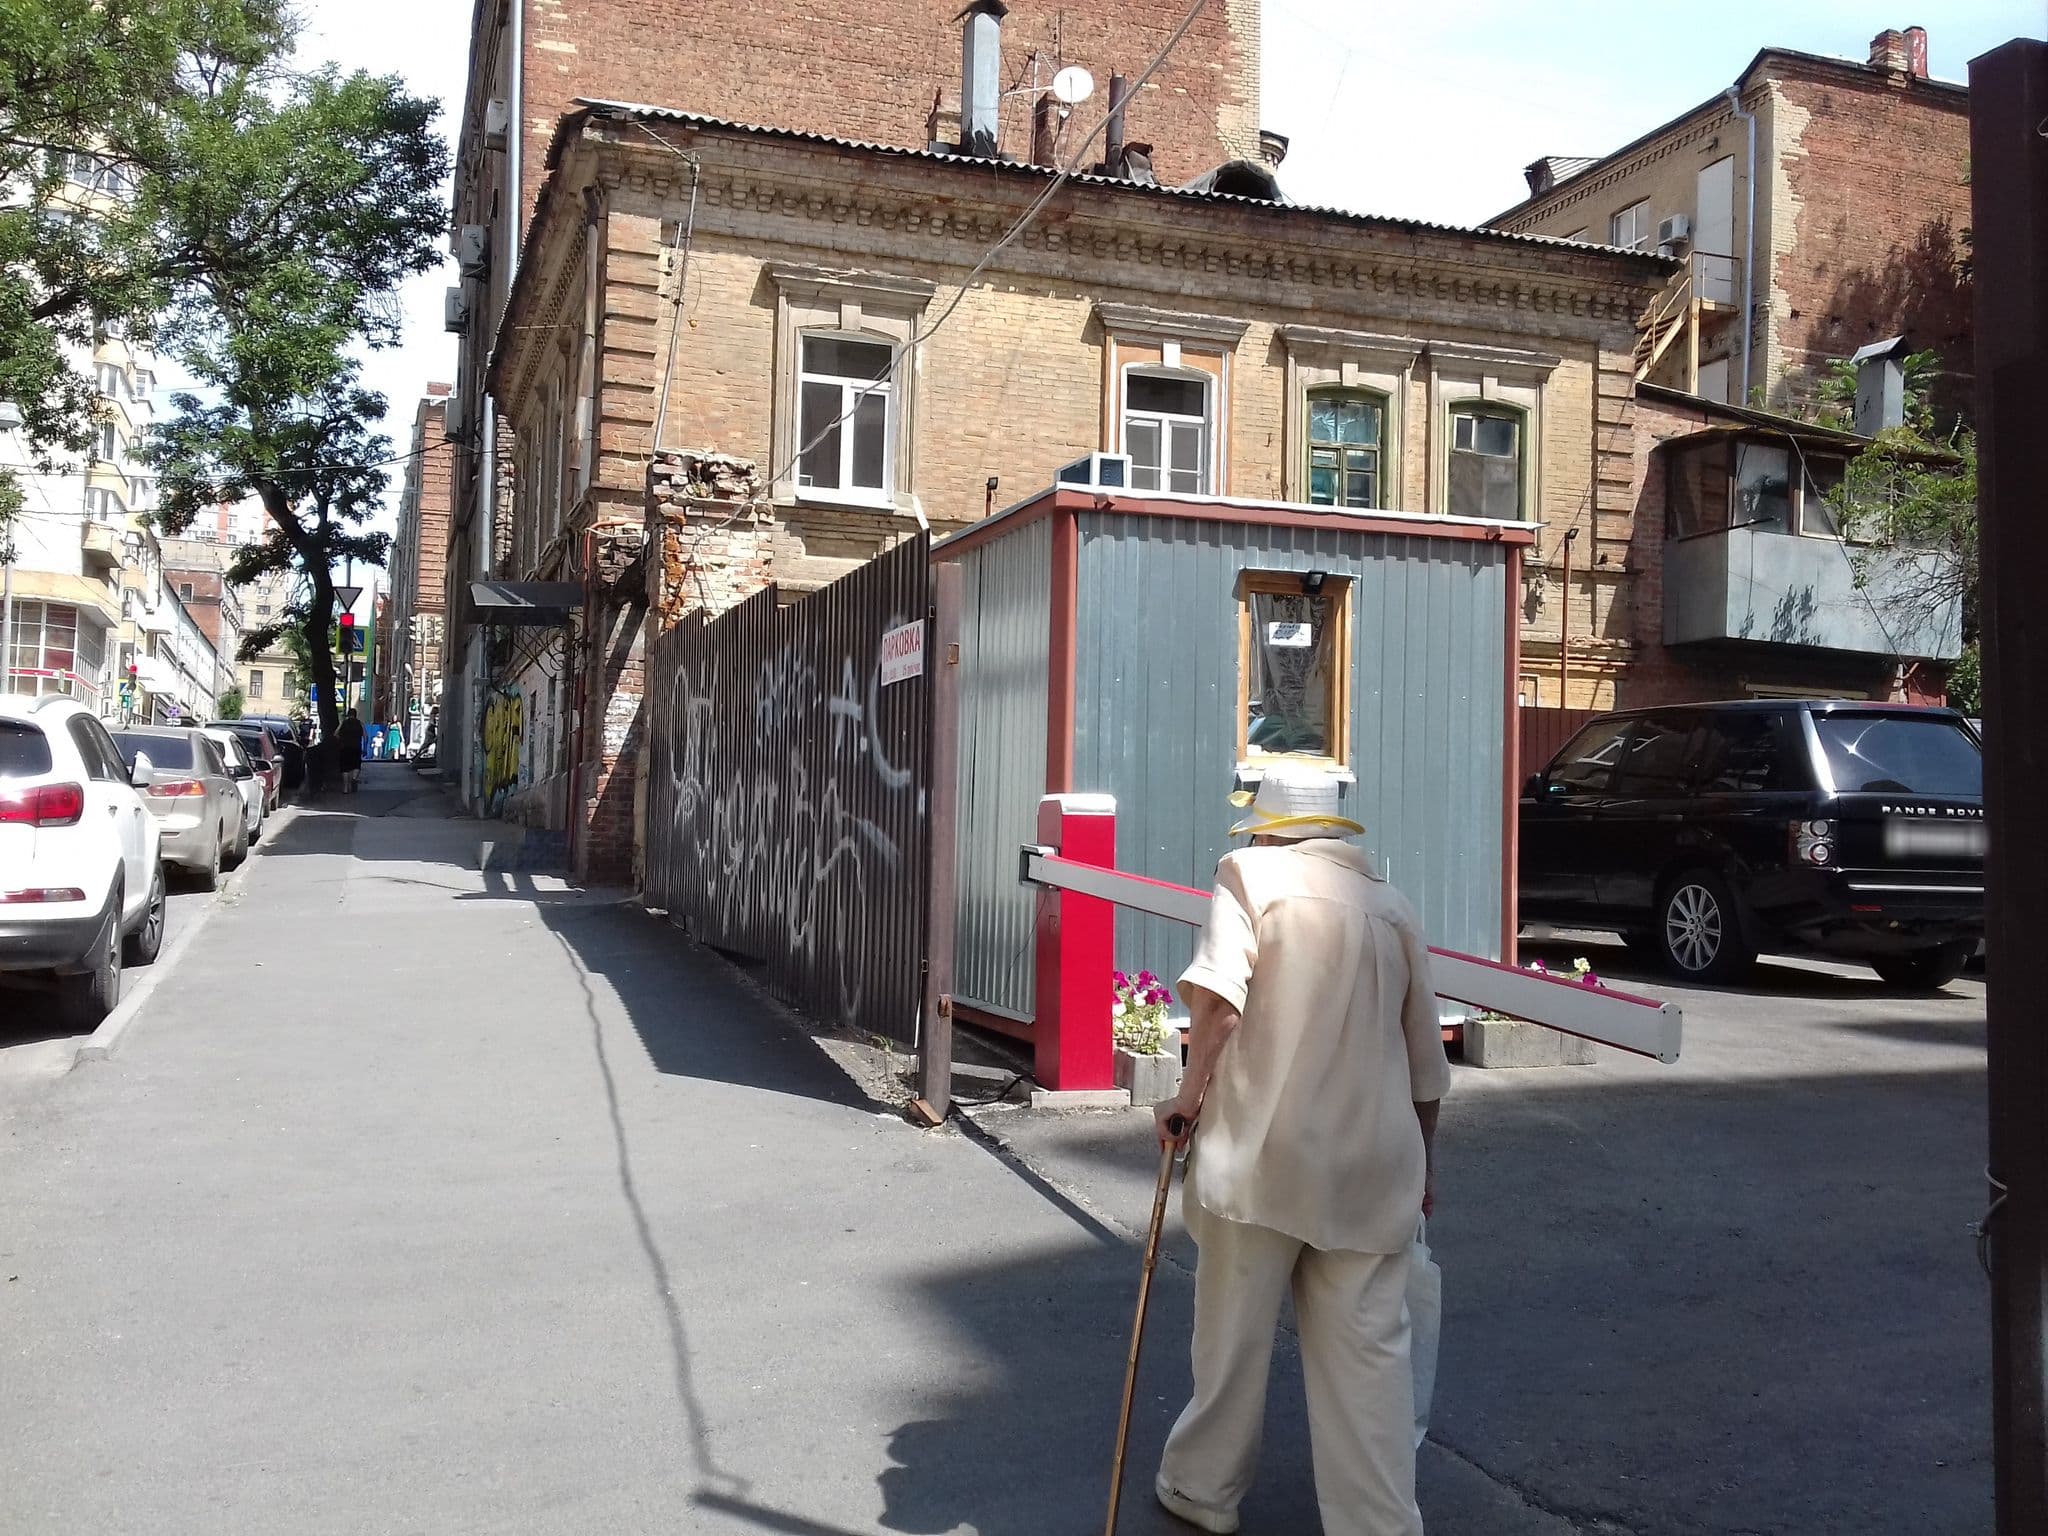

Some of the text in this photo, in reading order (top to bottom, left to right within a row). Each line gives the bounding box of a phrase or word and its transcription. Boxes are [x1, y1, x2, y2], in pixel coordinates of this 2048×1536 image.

[883, 625, 921, 664] ПАРКОВКА
[1881, 805, 1984, 817] RANGE ROVE
